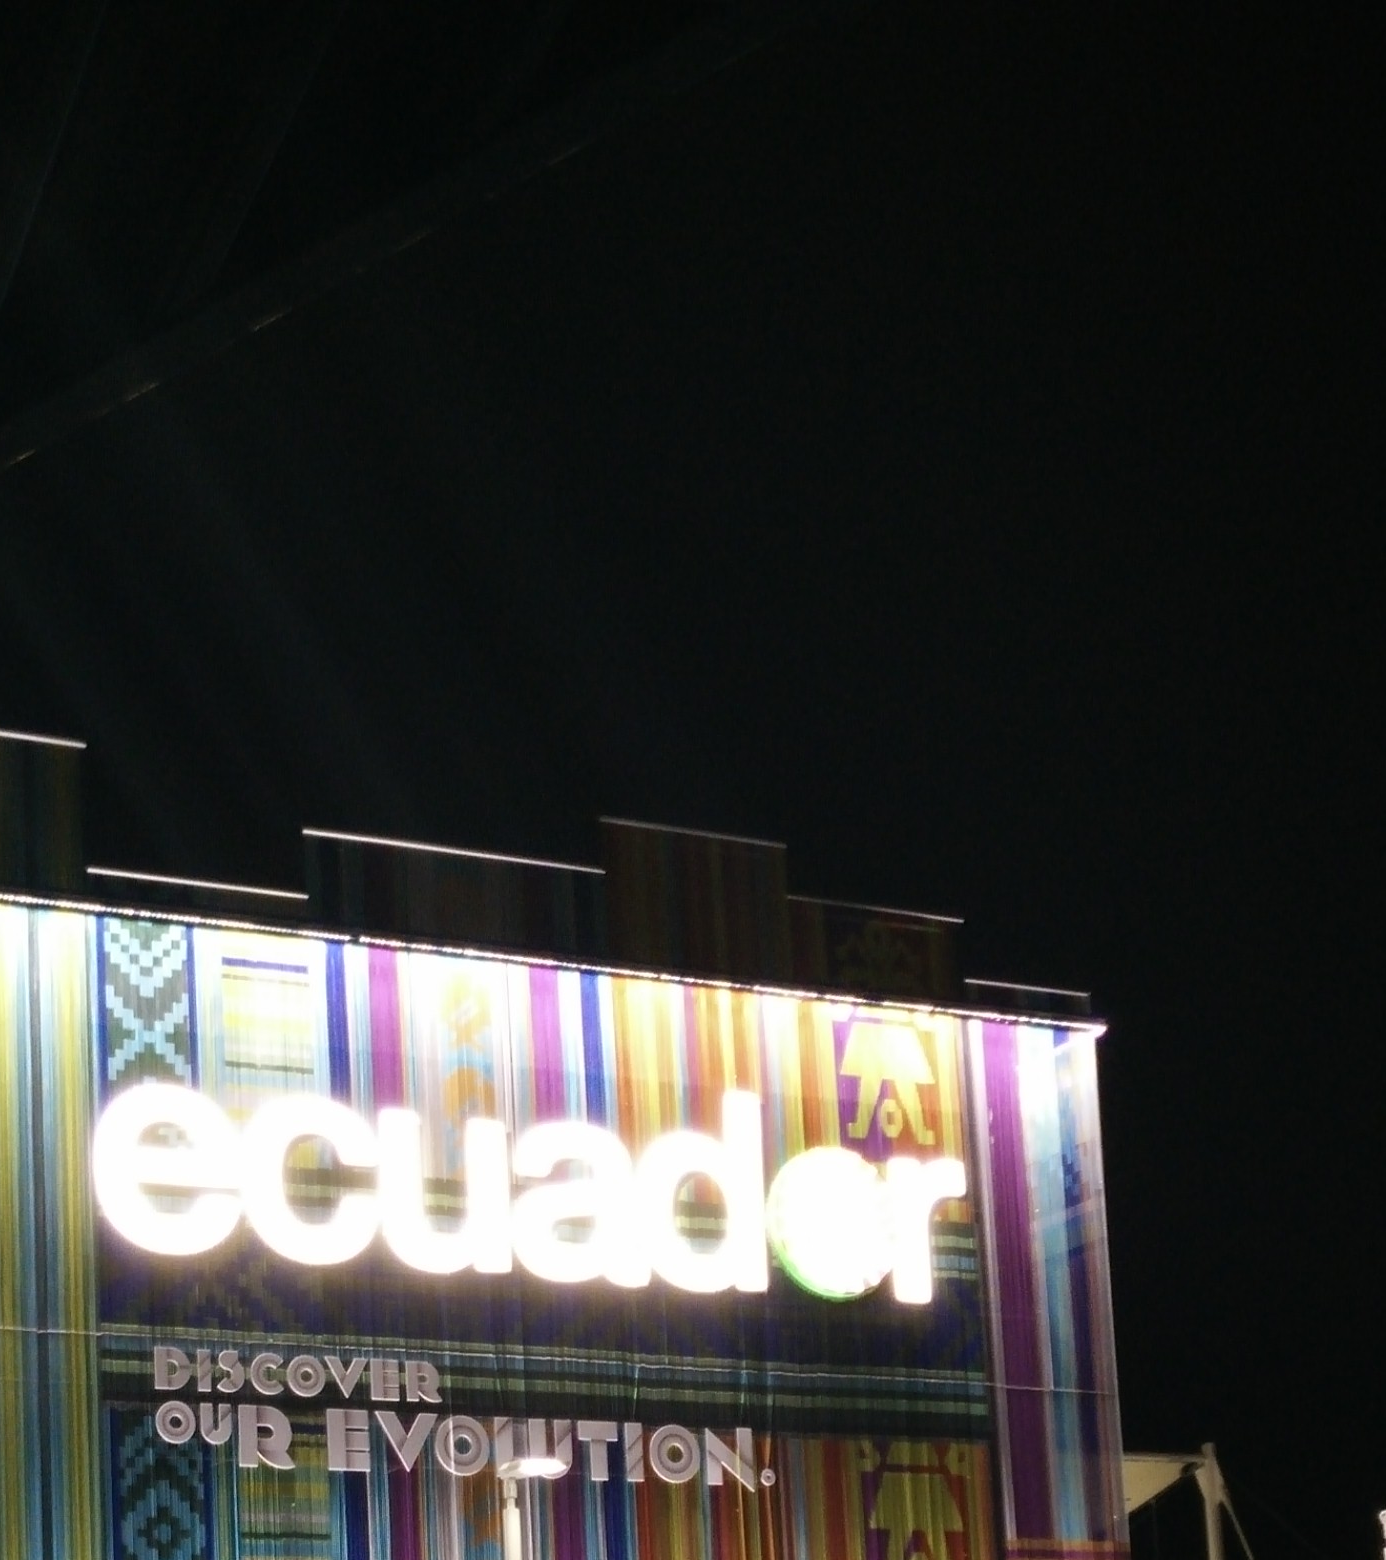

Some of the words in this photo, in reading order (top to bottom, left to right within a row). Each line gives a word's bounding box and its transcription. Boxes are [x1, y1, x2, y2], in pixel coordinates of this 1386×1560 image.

[92, 1082, 967, 1305] ecuador
[153, 1346, 442, 1403] DISCOVER
[156, 1401, 295, 1470] OUR
